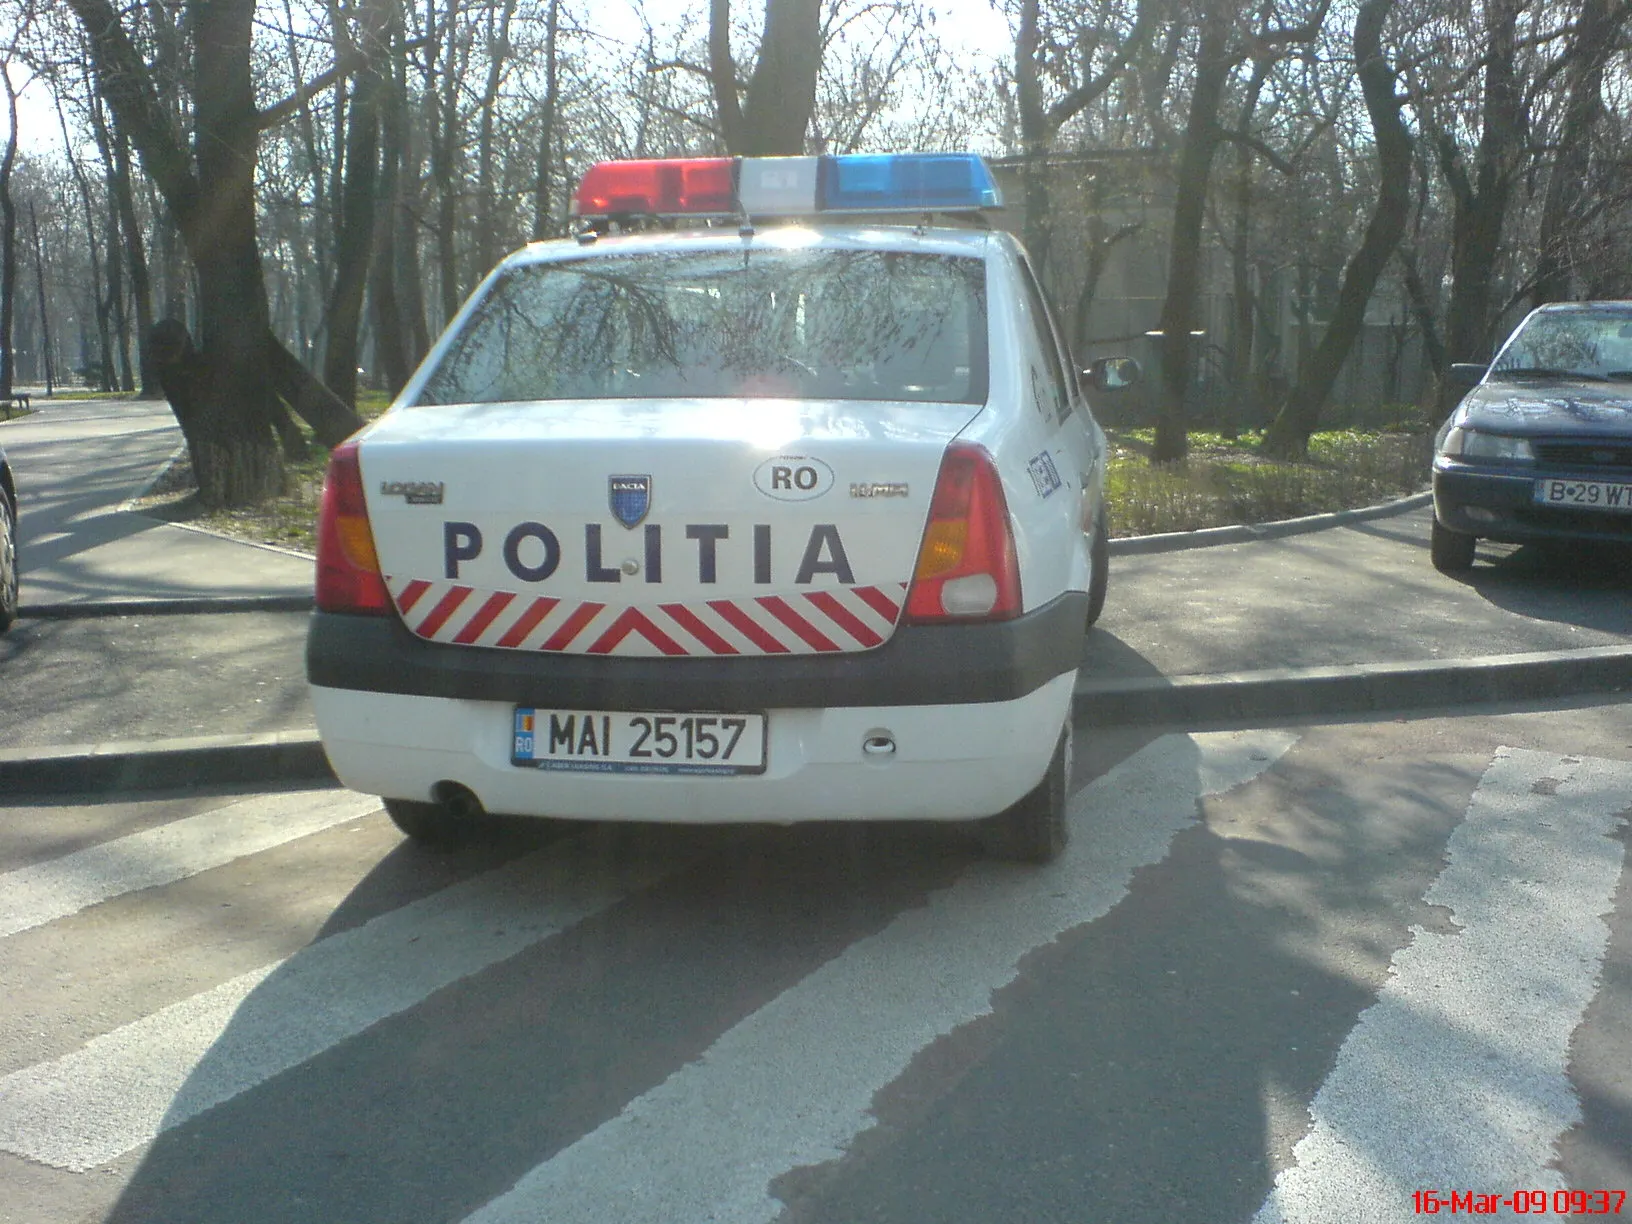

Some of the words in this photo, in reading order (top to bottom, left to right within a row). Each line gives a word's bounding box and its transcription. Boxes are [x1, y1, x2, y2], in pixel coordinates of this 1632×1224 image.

[772, 466, 818, 490] RO
[444, 521, 856, 584] POLITIA
[515, 737, 533, 753] RO
[549, 714, 611, 756] MAI
[629, 716, 747, 760] 25157
